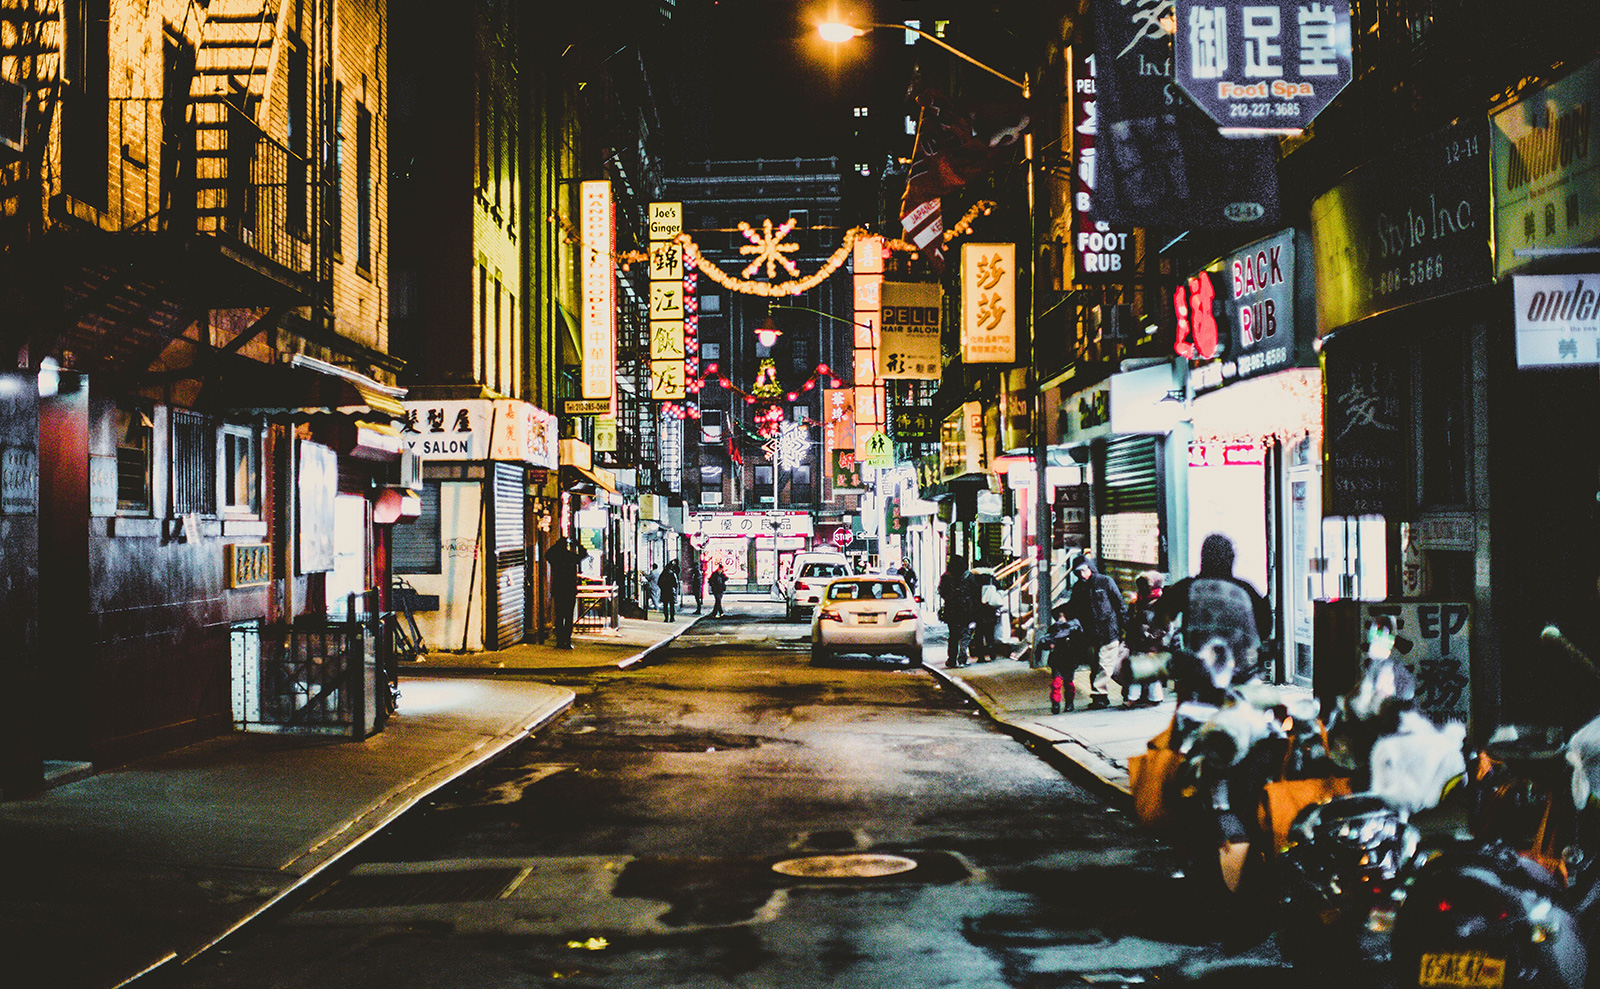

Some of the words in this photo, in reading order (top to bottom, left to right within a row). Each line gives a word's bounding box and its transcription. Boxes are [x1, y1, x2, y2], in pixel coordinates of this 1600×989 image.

[1189, 3, 1339, 78] 御足堂
[1218, 81, 1268, 99] Foot
[1272, 79, 1315, 99] Spa
[1230, 103, 1301, 117] 212-227-3685
[1446, 135, 1479, 164] 12-14
[654, 207, 676, 219] Joe's
[1430, 193, 1476, 239] Inc.
[650, 221, 681, 235] Ginger
[1077, 232, 1128, 251] FOOT
[1083, 253, 1122, 272] RUB
[1232, 244, 1284, 300] BACK
[882, 307, 939, 324] PELL
[1240, 297, 1277, 347] RUB
[881, 325, 905, 333] HAIR
[423, 440, 468, 453] SALON
[720, 518, 791, 531] 優の良品
[834, 533, 853, 542] STOP
